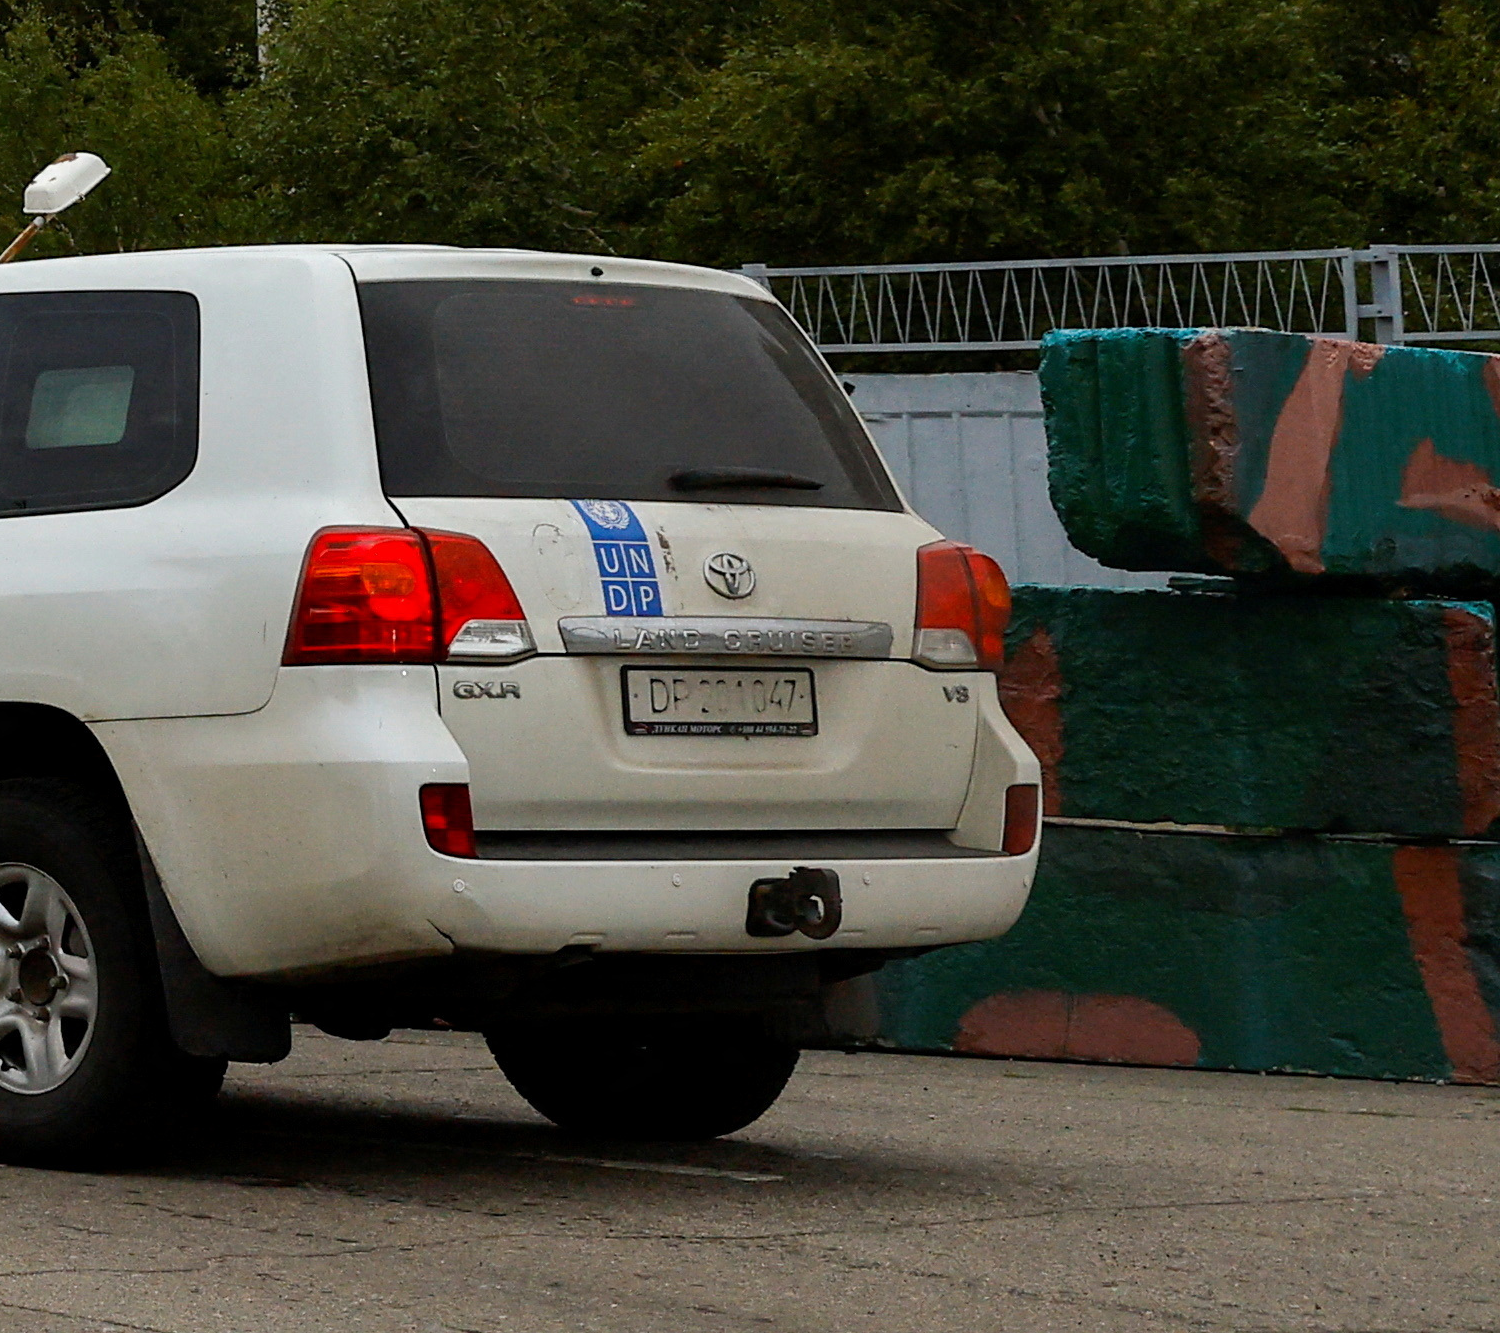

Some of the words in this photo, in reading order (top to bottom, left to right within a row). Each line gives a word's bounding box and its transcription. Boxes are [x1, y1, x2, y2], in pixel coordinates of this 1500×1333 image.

[613, 628, 701, 651] LAND
[723, 629, 855, 654] CRUISER
[453, 679, 522, 700] GXR
[699, 679, 797, 713] 047
